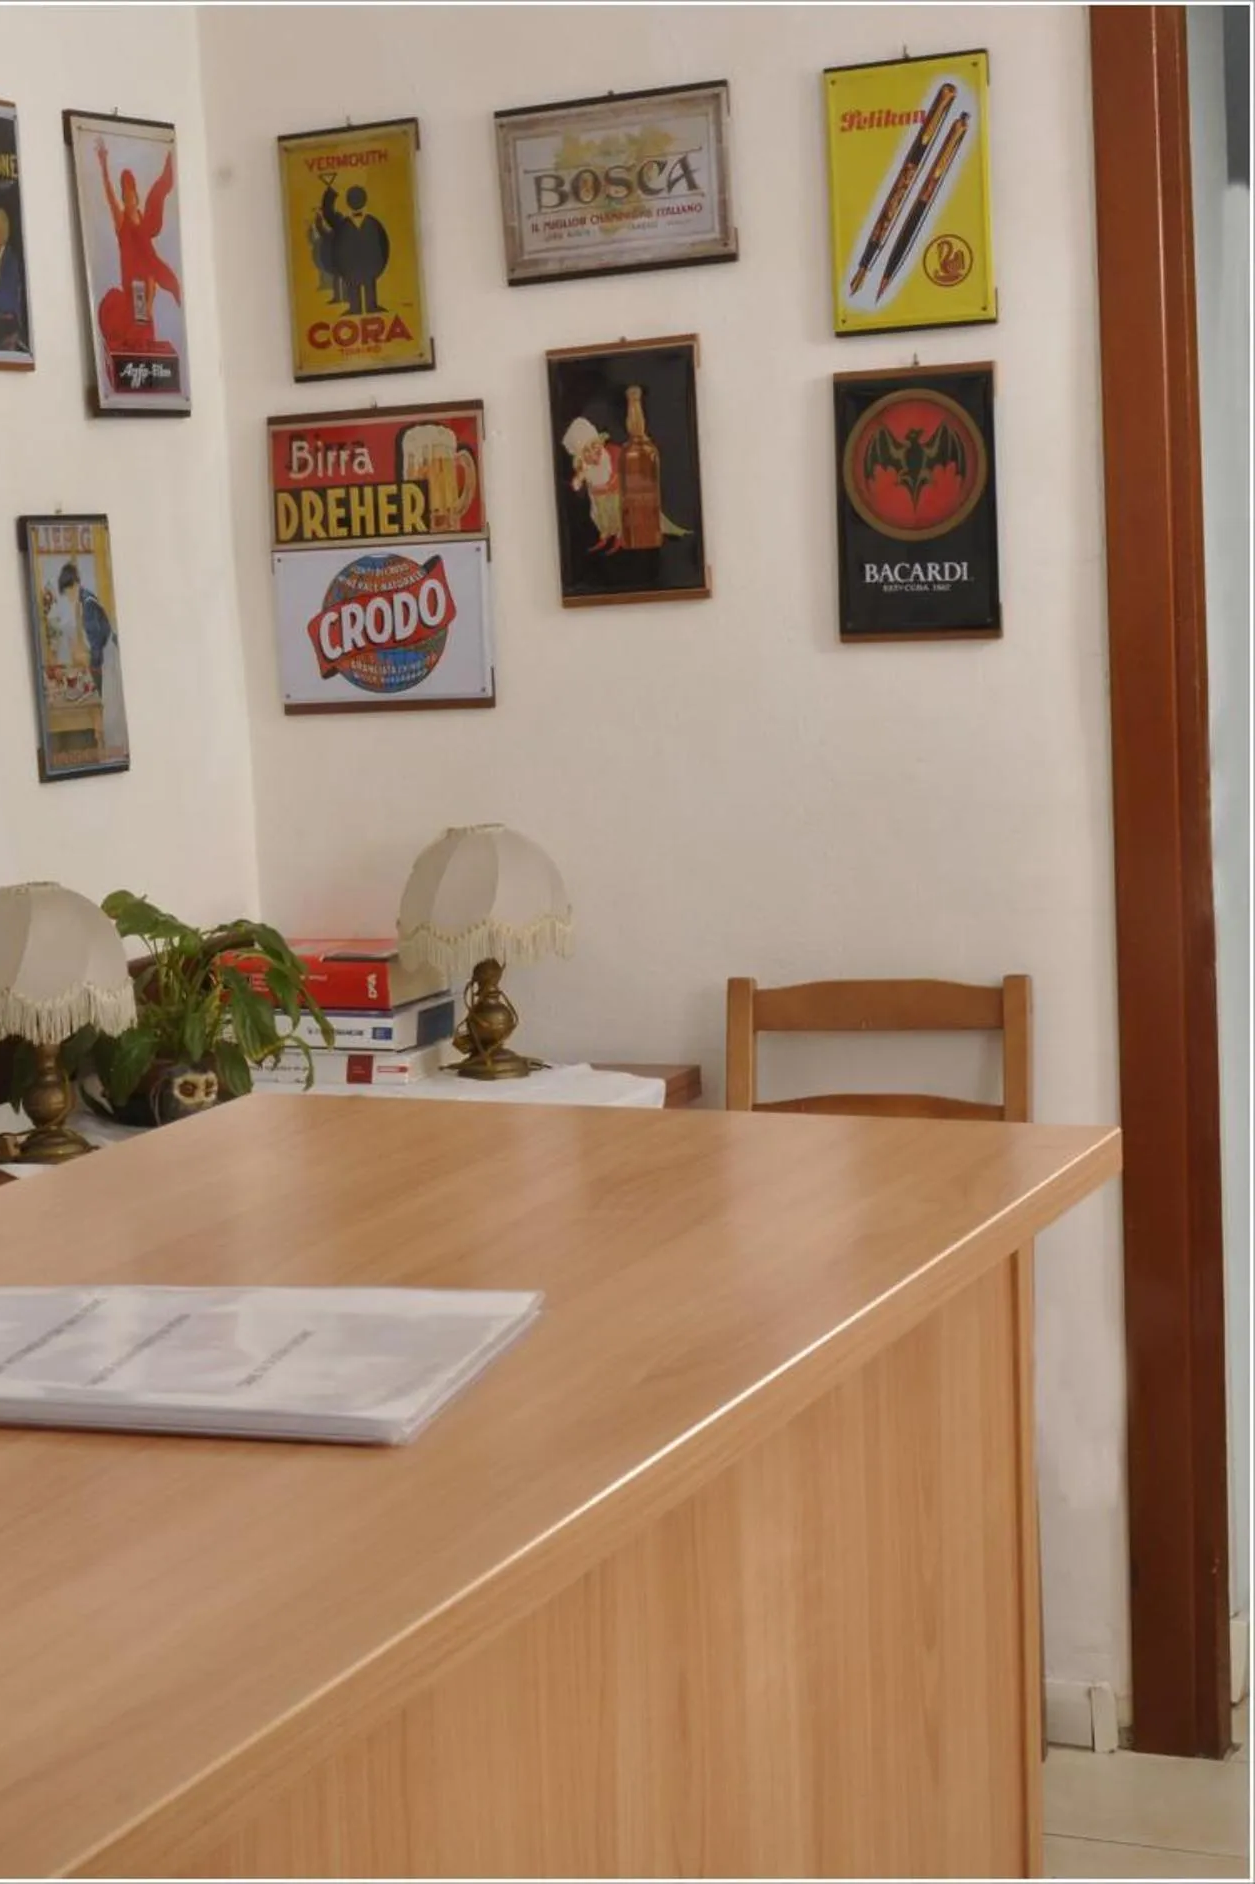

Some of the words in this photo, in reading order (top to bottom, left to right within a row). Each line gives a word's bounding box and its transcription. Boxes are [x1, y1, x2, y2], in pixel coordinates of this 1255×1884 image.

[840, 108, 927, 133] Pelikan
[305, 149, 388, 173] VERMOUTH
[533, 150, 702, 213] BOSCA
[307, 314, 414, 351] CORA
[288, 436, 374, 480] Birra
[275, 482, 428, 542] DREHER
[864, 561, 968, 583] BACARDI
[319, 578, 446, 661] CRODO
